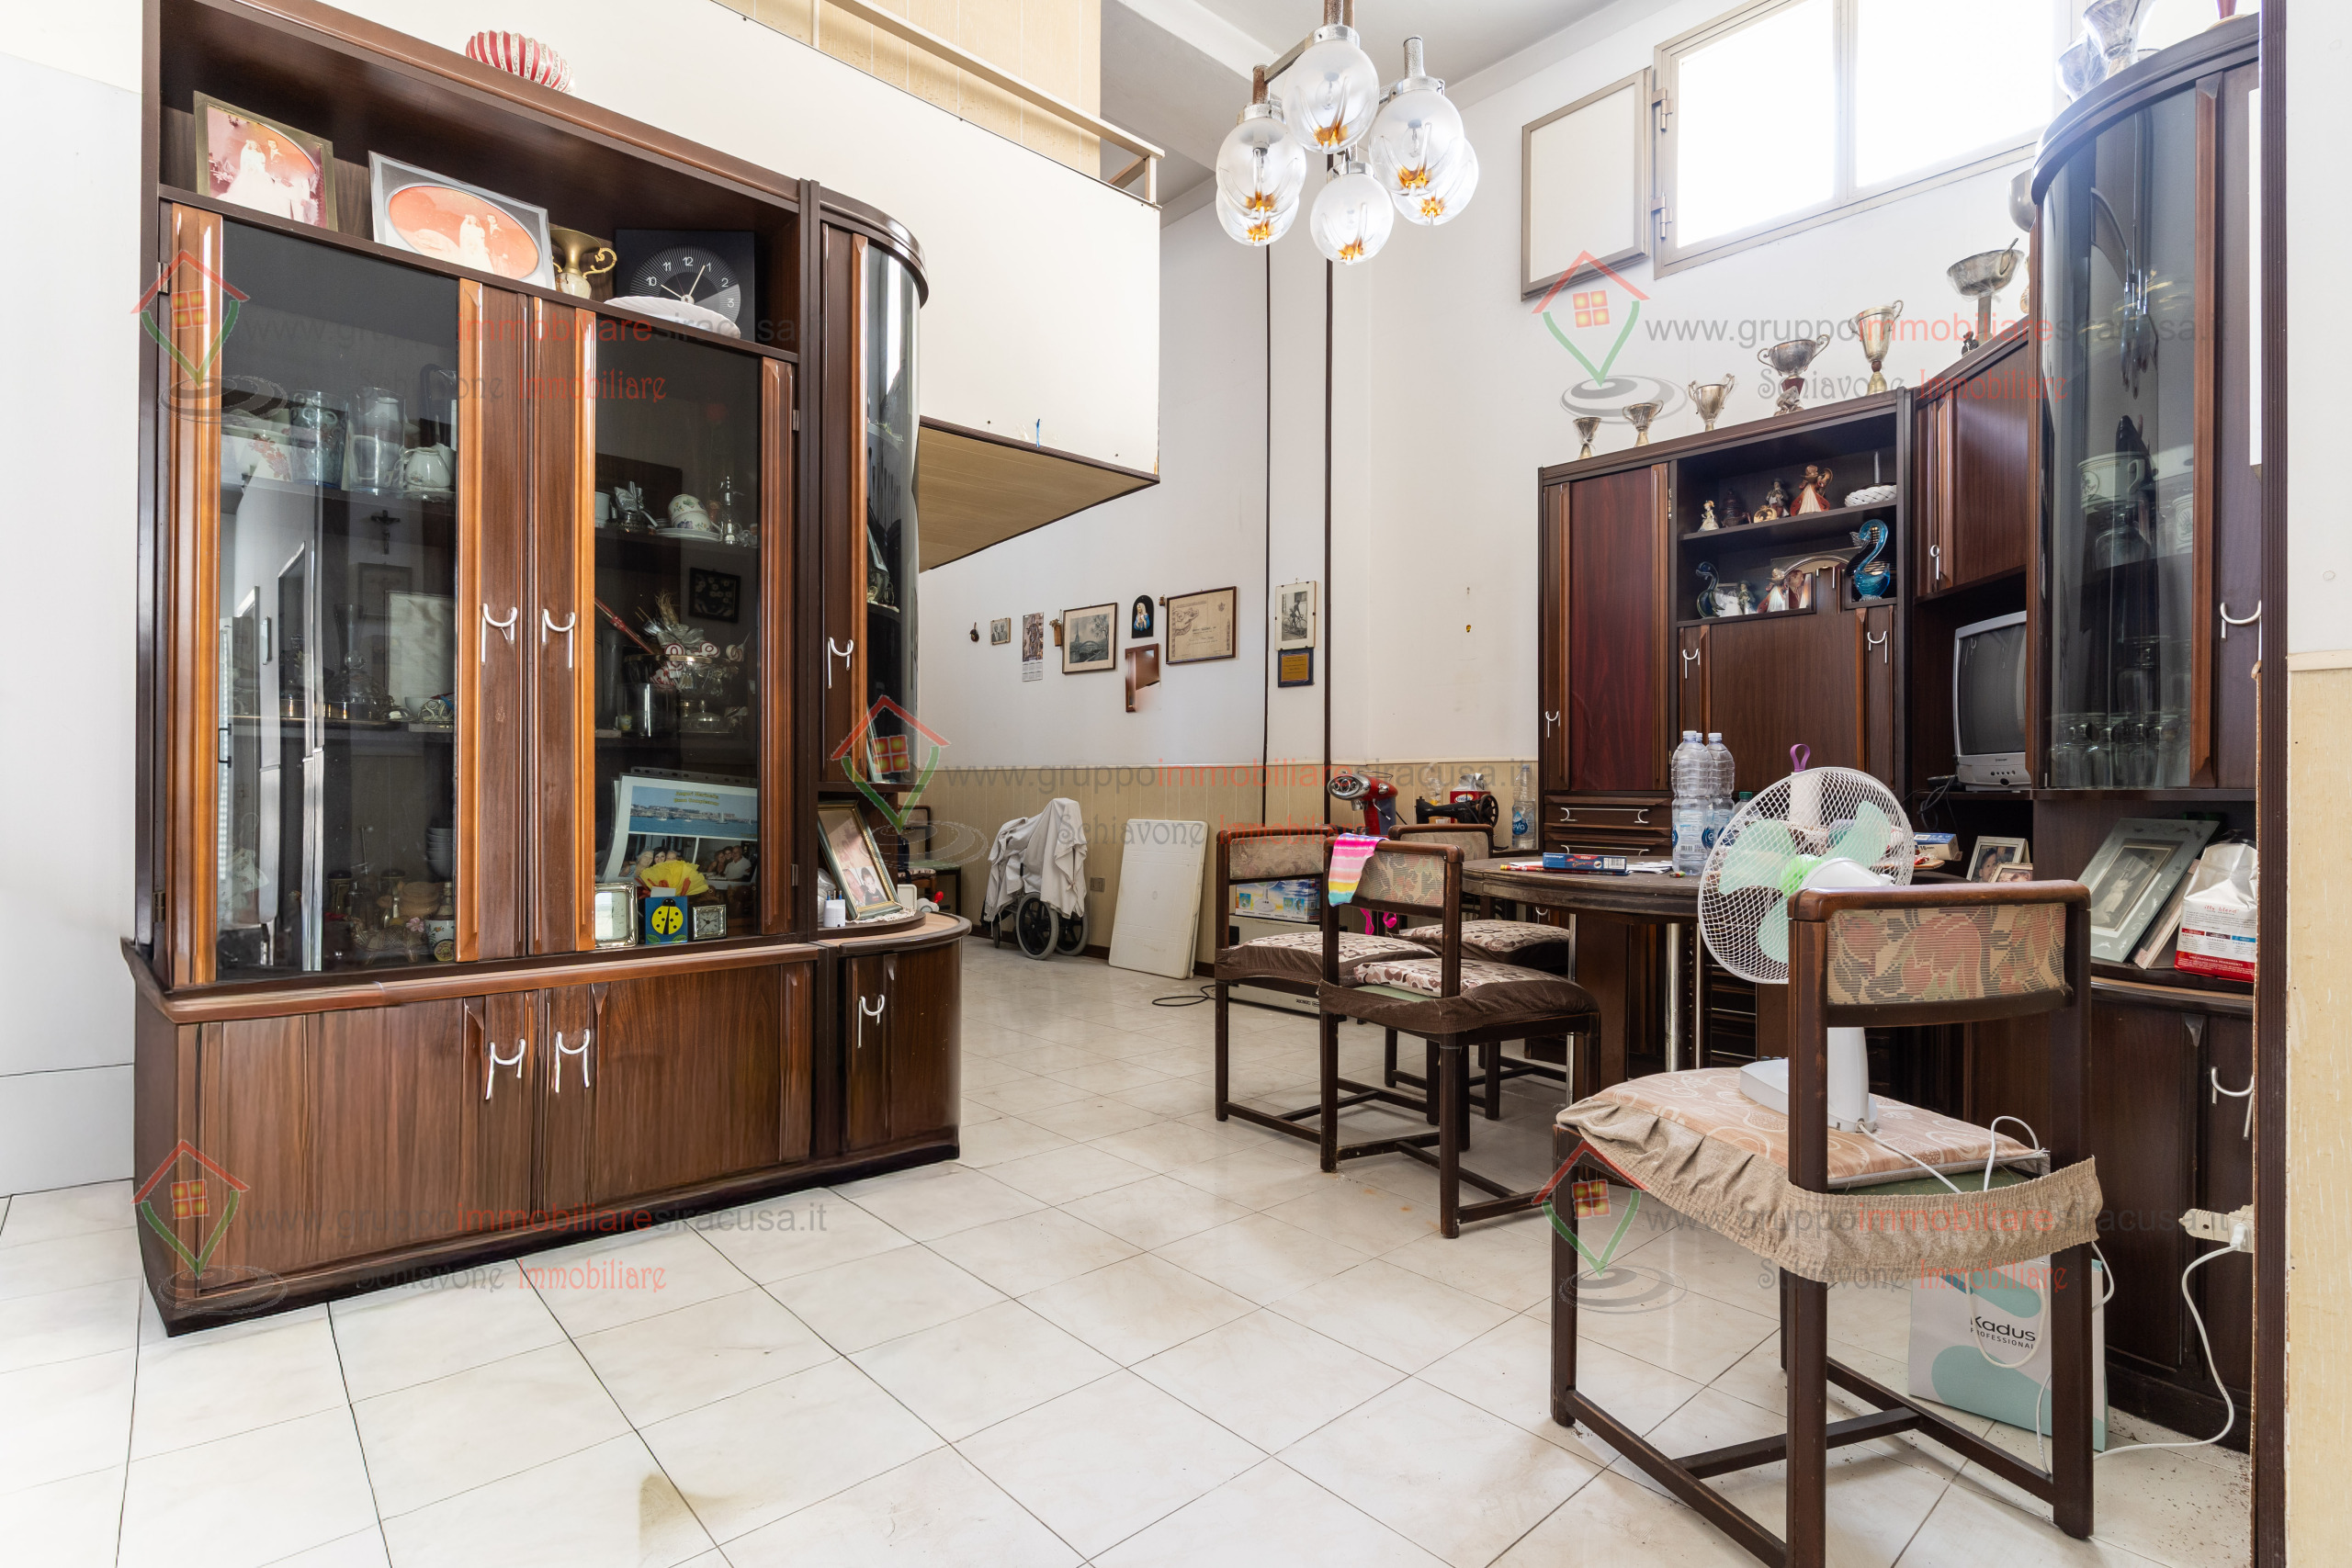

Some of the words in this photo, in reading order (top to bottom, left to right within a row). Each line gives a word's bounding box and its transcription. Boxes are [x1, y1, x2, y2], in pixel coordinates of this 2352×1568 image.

[683, 256, 693, 266] 12
[663, 262, 672, 272] 11
[646, 276, 657, 287] 10
[721, 278, 729, 288] 2
[727, 298, 735, 308] 3
[1970, 1315, 2036, 1342] Kadus
